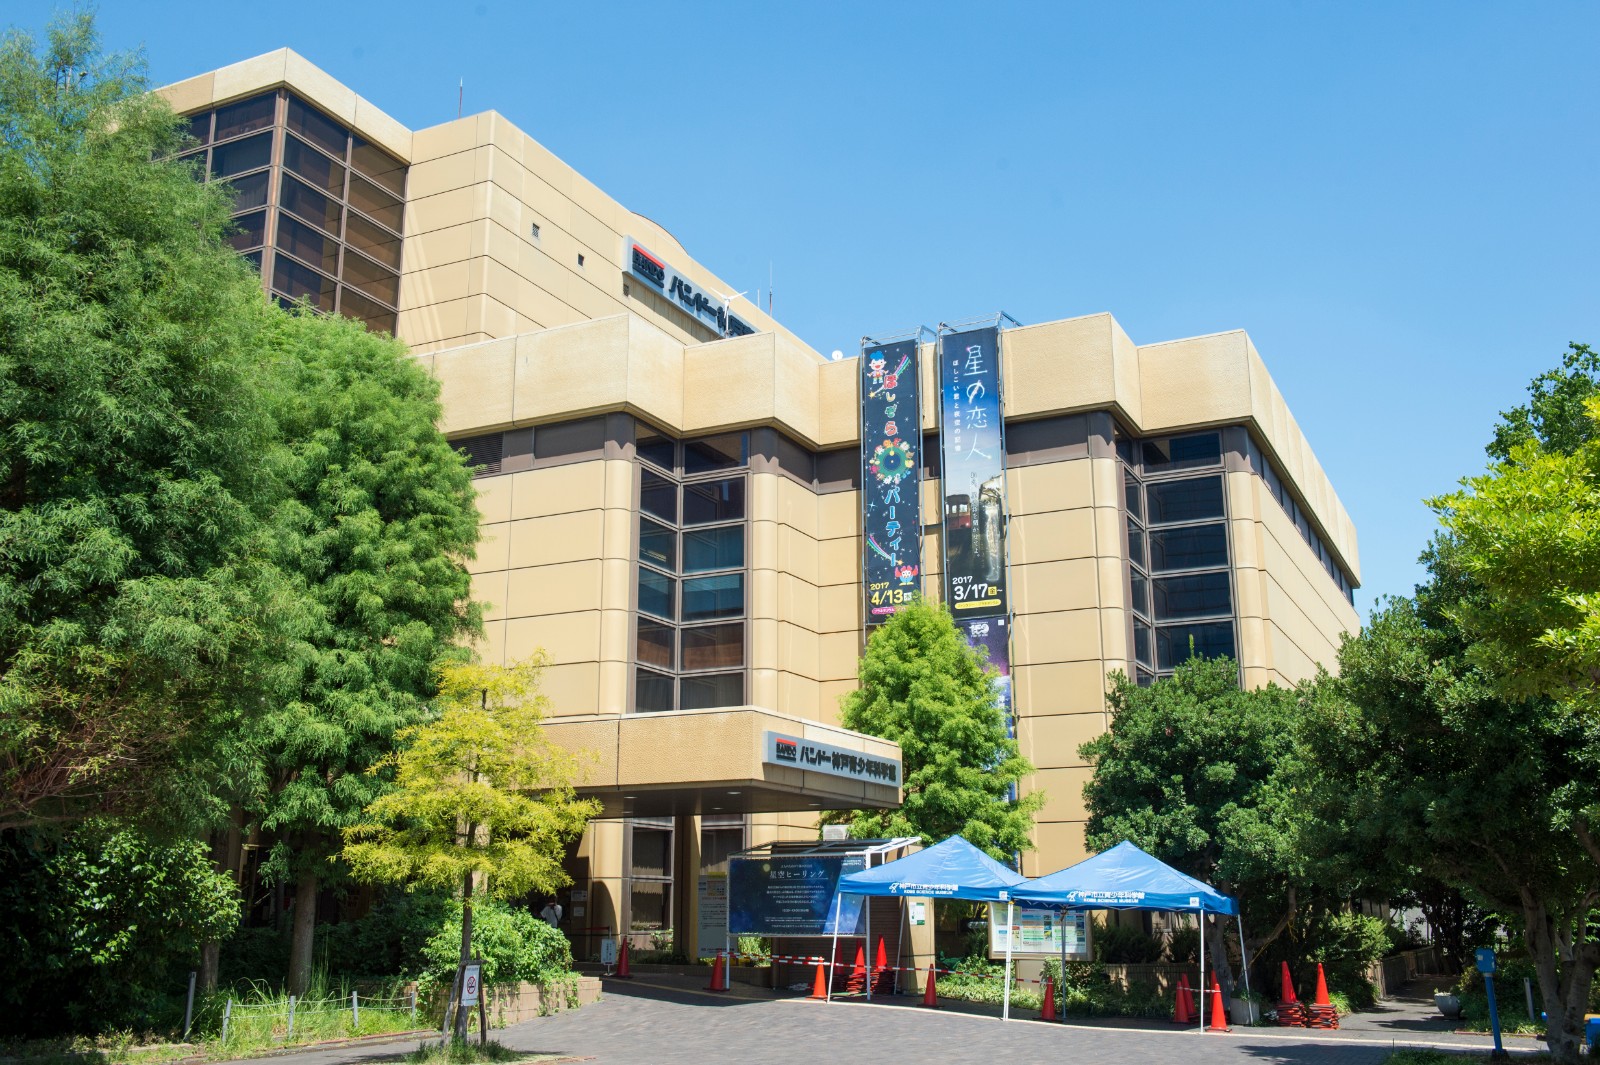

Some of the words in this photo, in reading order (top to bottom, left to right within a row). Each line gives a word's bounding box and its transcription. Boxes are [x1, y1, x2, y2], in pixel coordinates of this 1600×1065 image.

[963, 345, 992, 461] 星の恋人
[884, 486, 901, 568] パーティー
[870, 582, 890, 590] 2017
[952, 575, 973, 585] 2017
[870, 589, 903, 606] 4/13
[954, 583, 988, 600] 3/17
[776, 743, 797, 757] BANDO
[770, 870, 825, 879] 星空ヒーリング
